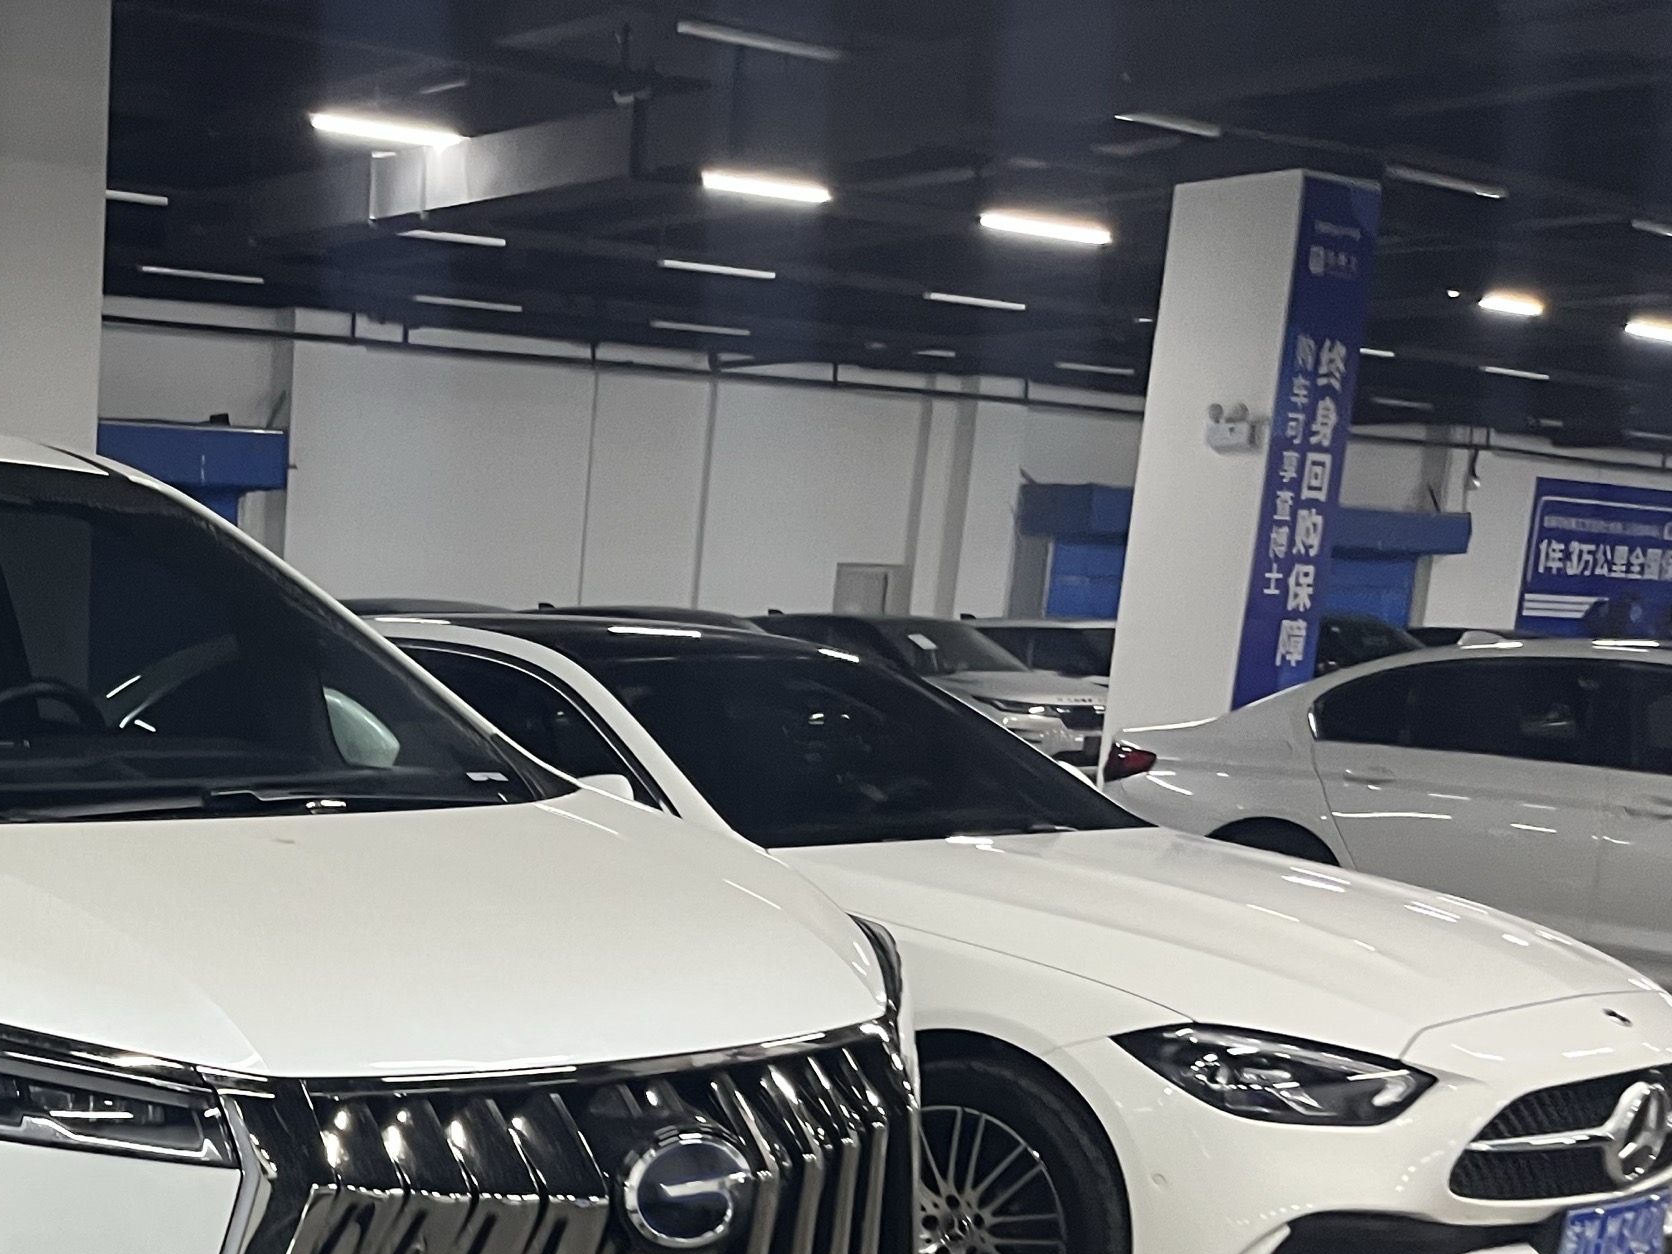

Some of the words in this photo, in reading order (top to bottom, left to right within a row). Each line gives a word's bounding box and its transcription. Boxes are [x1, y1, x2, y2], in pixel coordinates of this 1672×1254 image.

[1275, 337, 1347, 667] 终身回购保障
